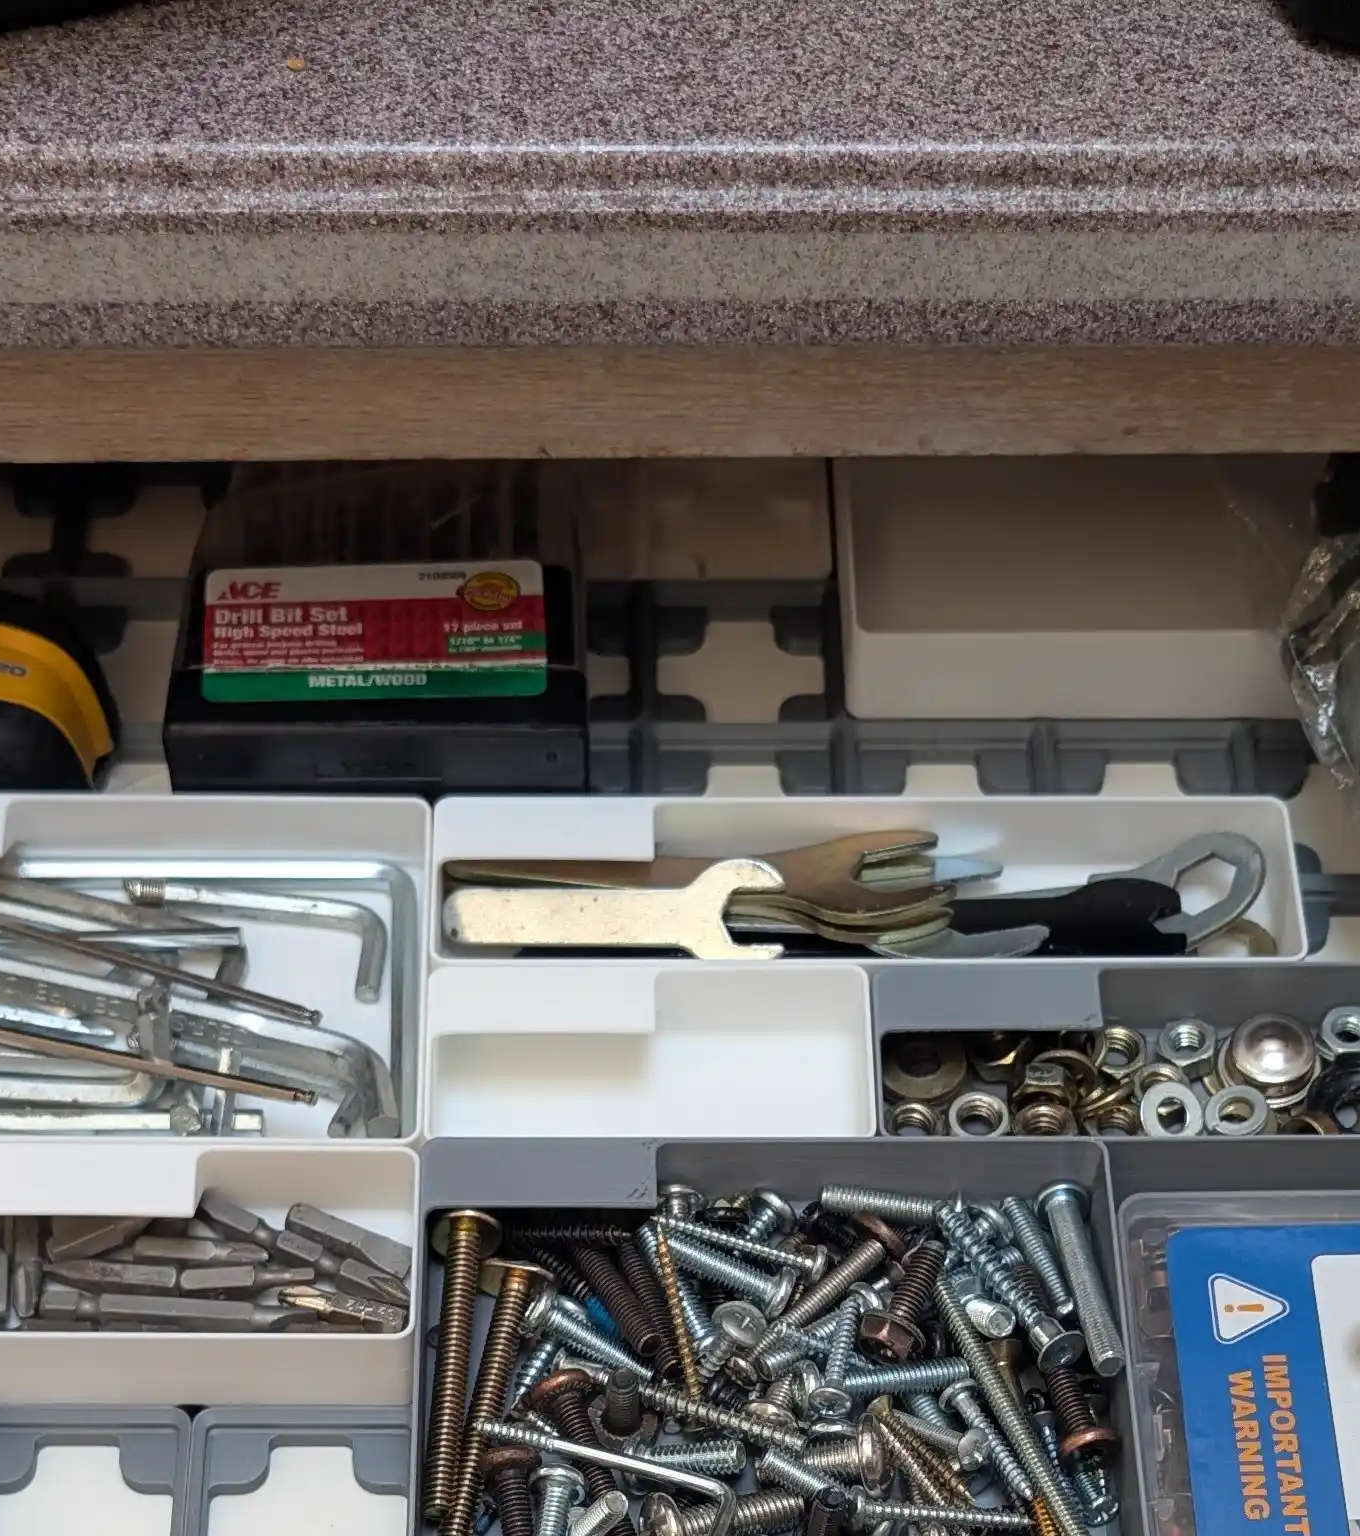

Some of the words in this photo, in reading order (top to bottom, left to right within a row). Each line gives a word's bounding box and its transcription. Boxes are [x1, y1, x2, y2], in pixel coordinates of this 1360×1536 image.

[218, 581, 282, 600] ACE
[214, 608, 263, 625] Drill
[269, 607, 303, 623] Bit
[309, 606, 348, 622] Set
[213, 626, 255, 640] High
[259, 624, 314, 640] Speed
[317, 622, 363, 637] Steel
[307, 673, 428, 688] METAL/WOOD
[1228, 1369, 1271, 1521] WARNING
